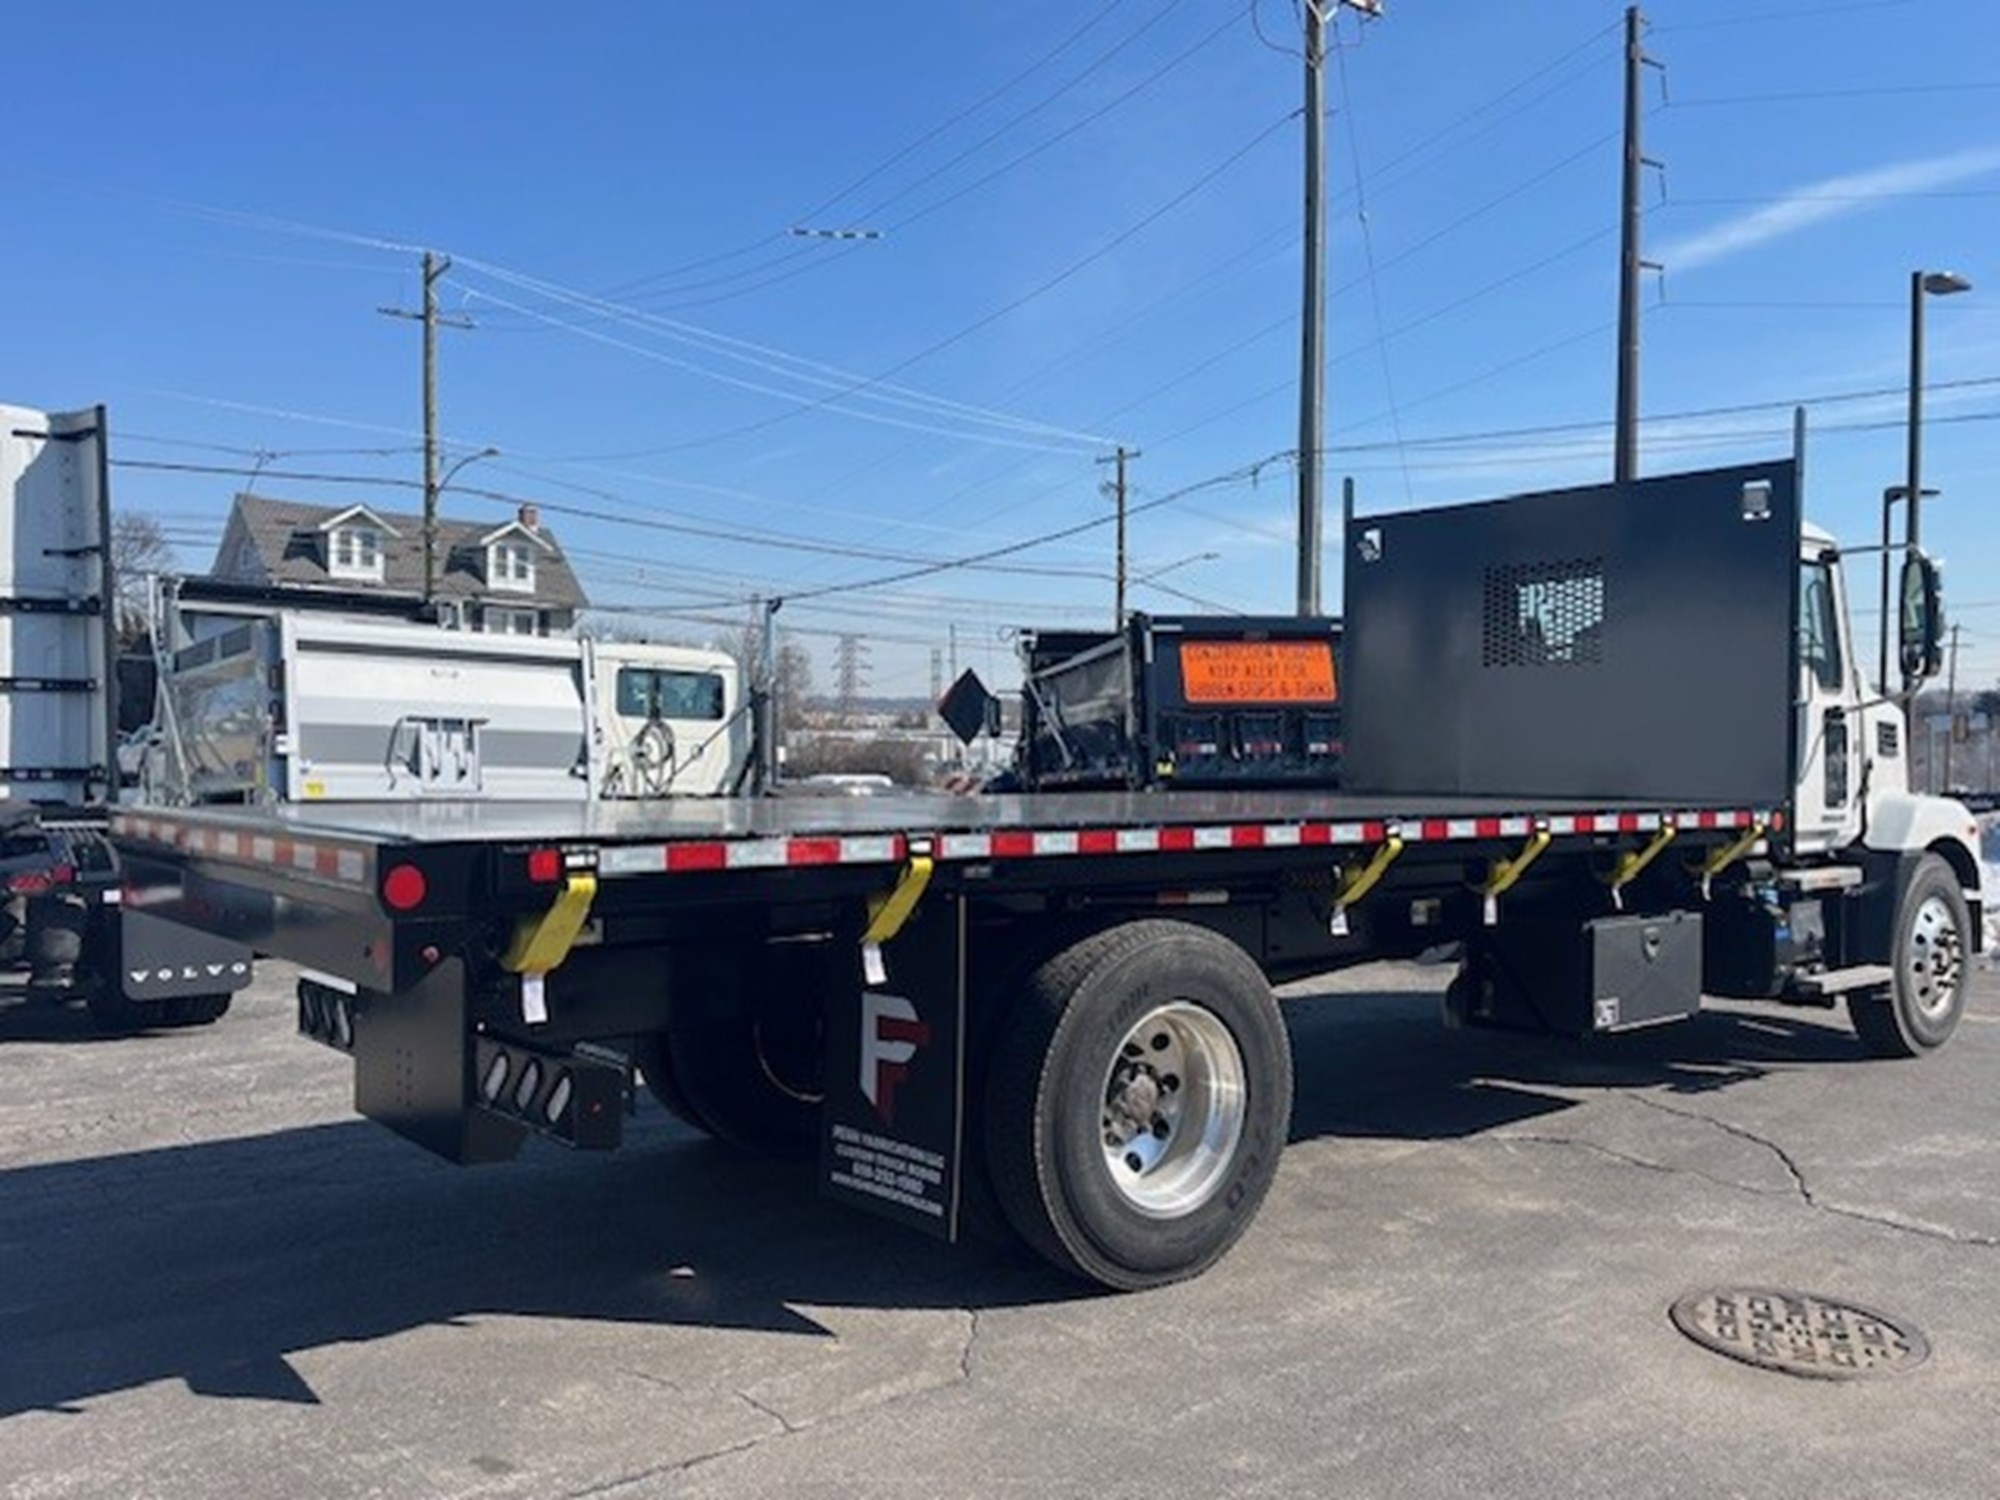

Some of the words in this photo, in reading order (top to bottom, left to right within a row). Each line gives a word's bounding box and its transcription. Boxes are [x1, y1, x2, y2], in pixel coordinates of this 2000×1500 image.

[1207, 664, 1239, 679] KEEP
[1244, 664, 1280, 679] ALERT
[1284, 664, 1308, 679] FOR
[1238, 681, 1276, 698] STOPS
[129, 961, 247, 983] VOLVO
